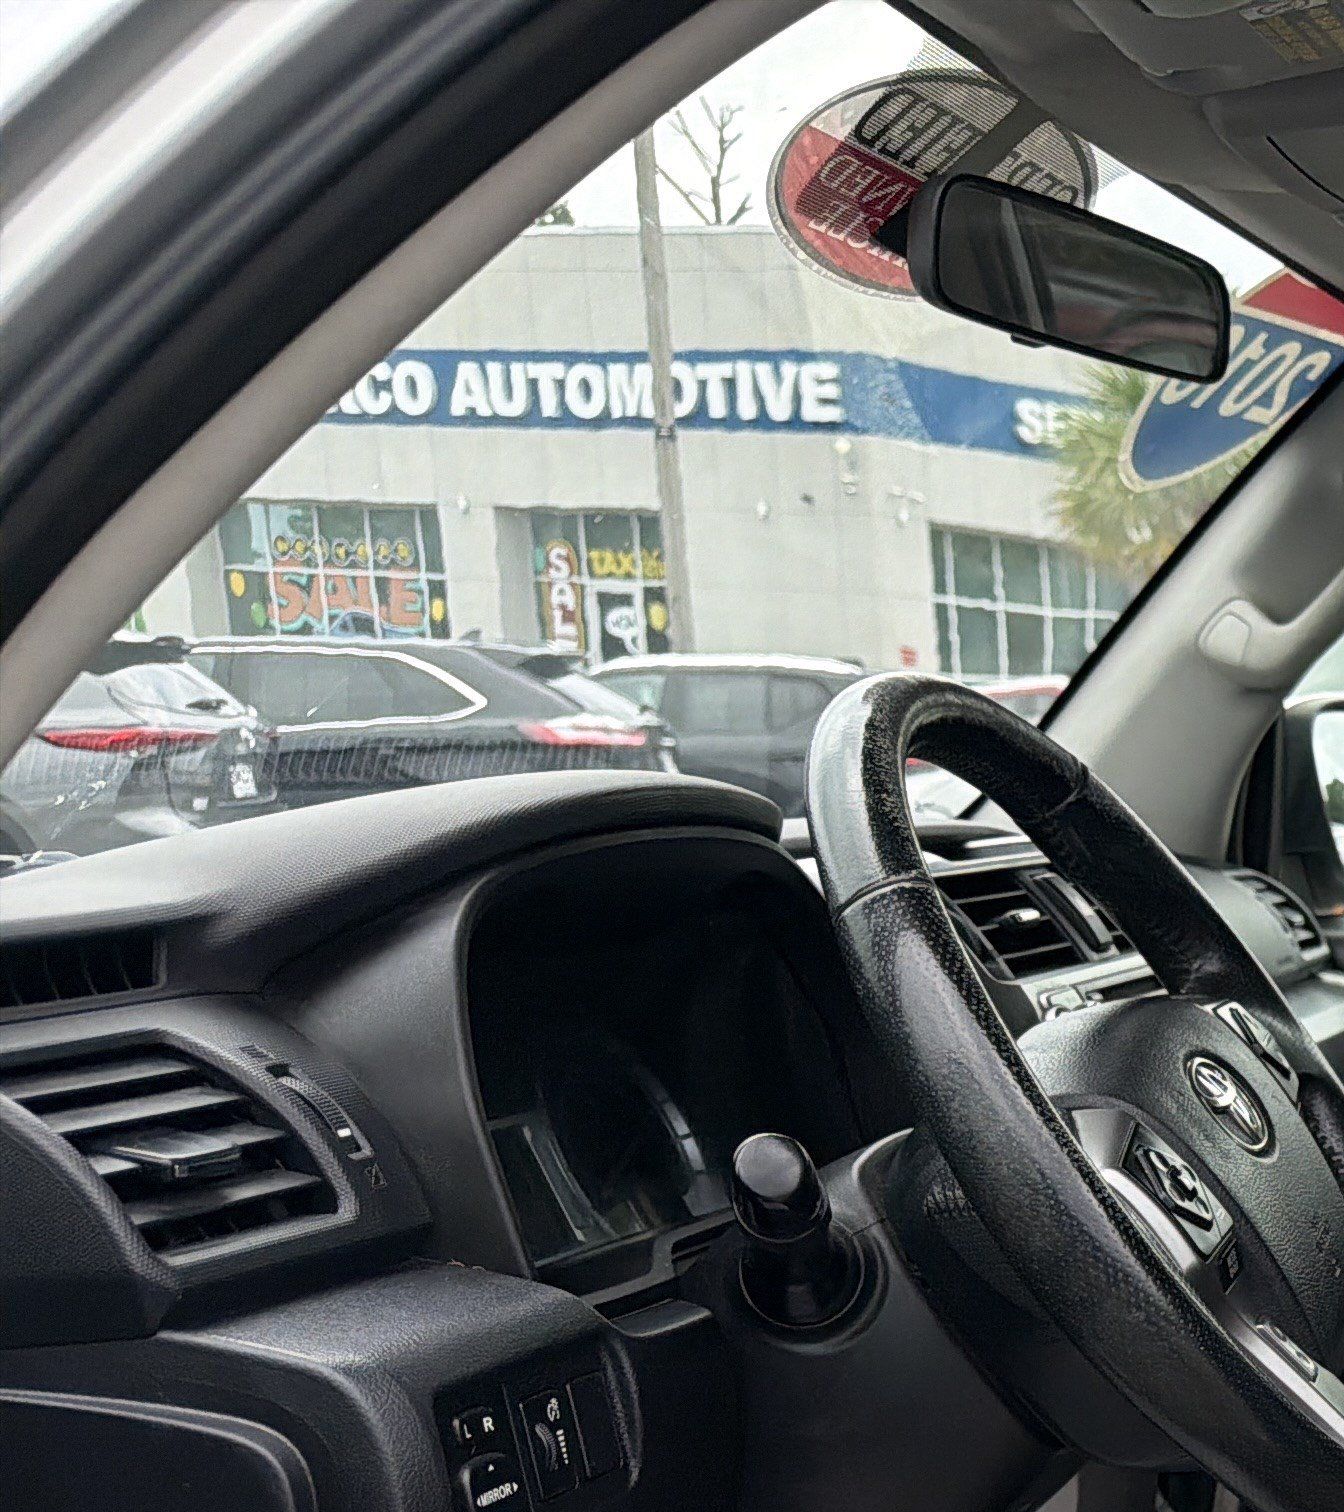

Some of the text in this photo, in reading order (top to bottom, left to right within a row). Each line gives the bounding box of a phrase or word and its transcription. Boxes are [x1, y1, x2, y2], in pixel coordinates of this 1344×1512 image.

[449, 361, 843, 423] AUTOMOTIVE
[266, 559, 425, 628] SALE
[464, 1417, 494, 1438] L R
[480, 1483, 513, 1507] MIRROR
